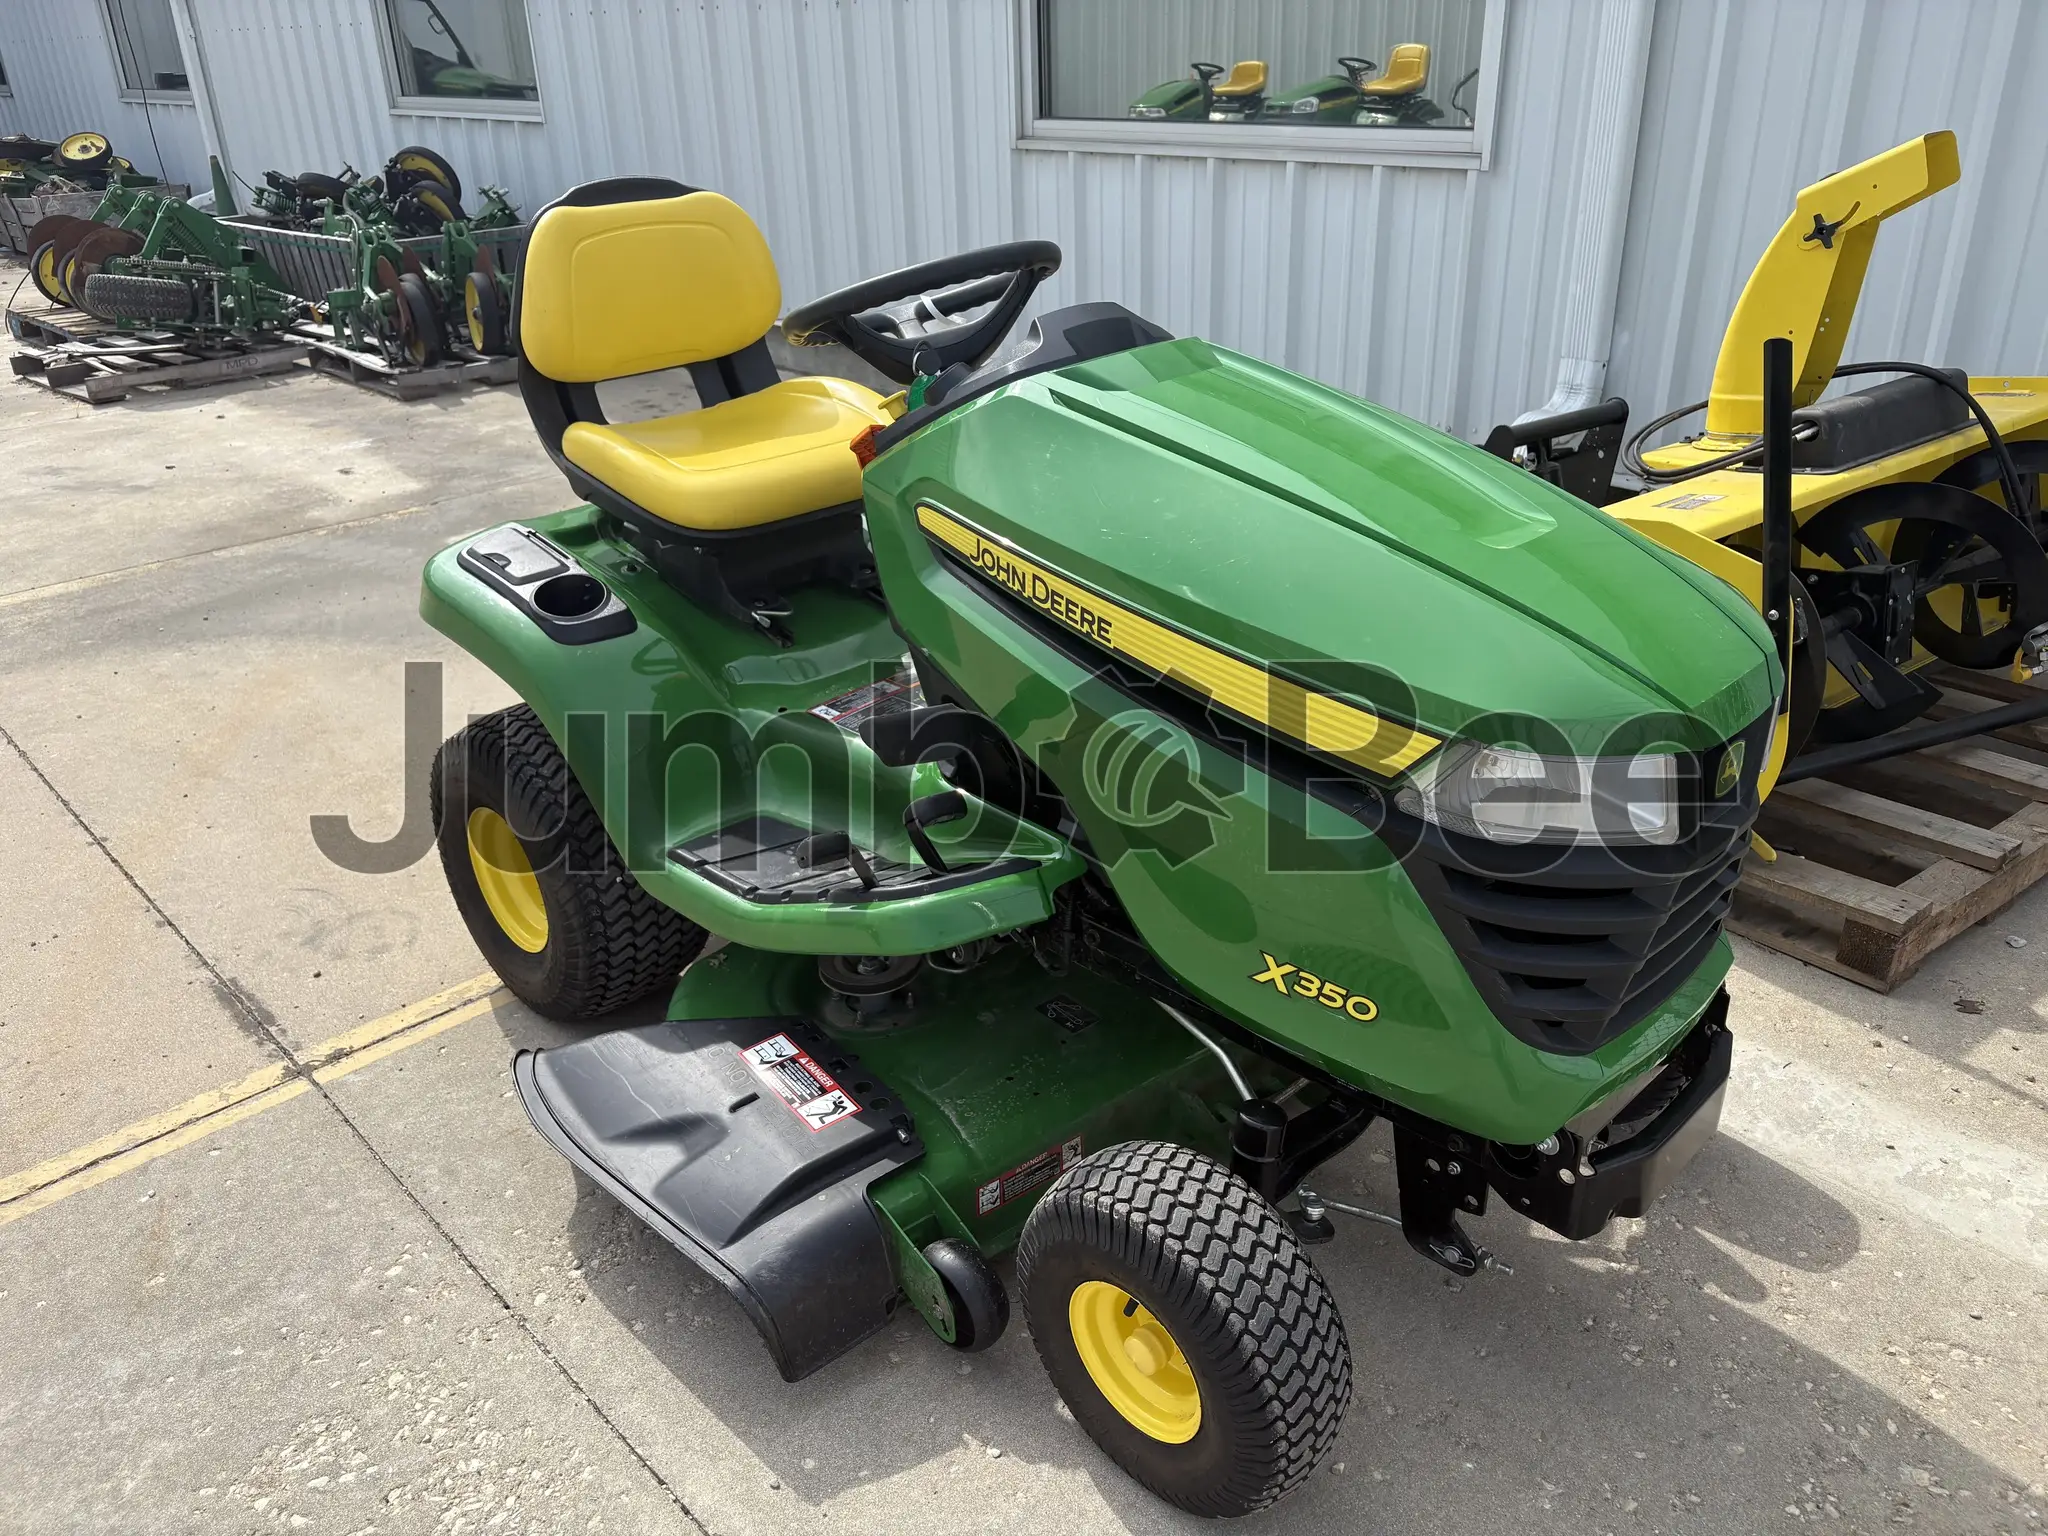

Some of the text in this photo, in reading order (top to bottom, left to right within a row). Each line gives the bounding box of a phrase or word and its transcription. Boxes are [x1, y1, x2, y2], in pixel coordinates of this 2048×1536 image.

[969, 537, 1113, 646] JOHN DEERE
[1249, 950, 1379, 1022] X350
[720, 1060, 758, 1090] NOT
[804, 1060, 835, 1088] DANGER
[1021, 1150, 1049, 1171] DANGER
